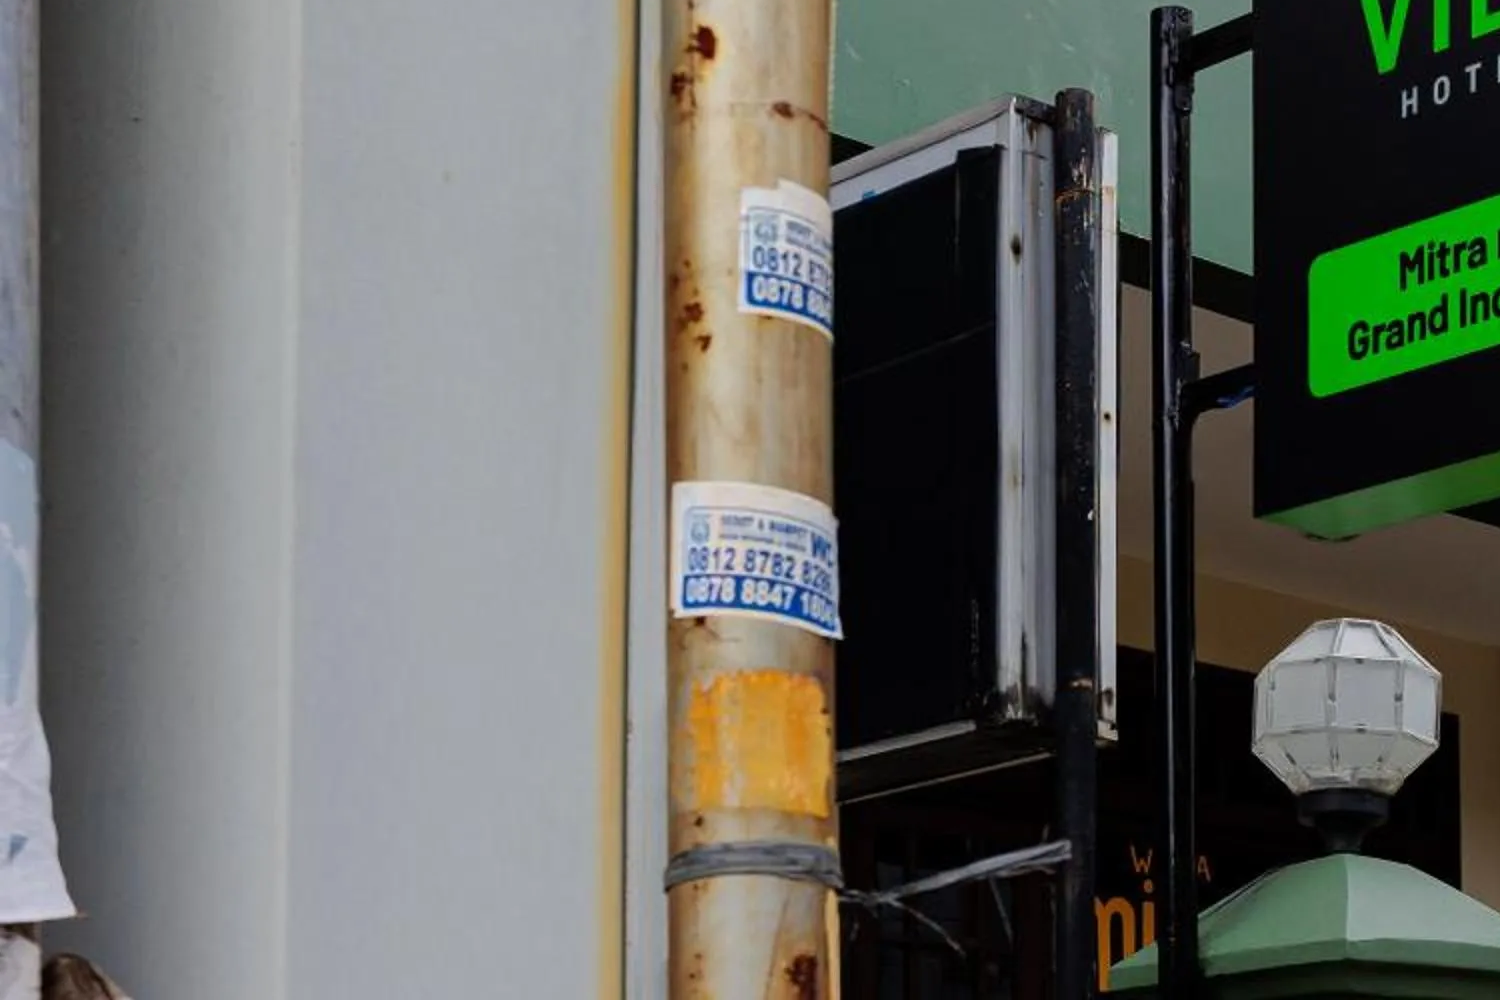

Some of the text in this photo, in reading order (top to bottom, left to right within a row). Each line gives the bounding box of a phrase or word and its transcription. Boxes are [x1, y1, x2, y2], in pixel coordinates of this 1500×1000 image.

[752, 245, 801, 277] 0812
[1399, 236, 1488, 291] Mitra
[1347, 293, 1449, 361] Grand
[743, 548, 796, 580] 8782
